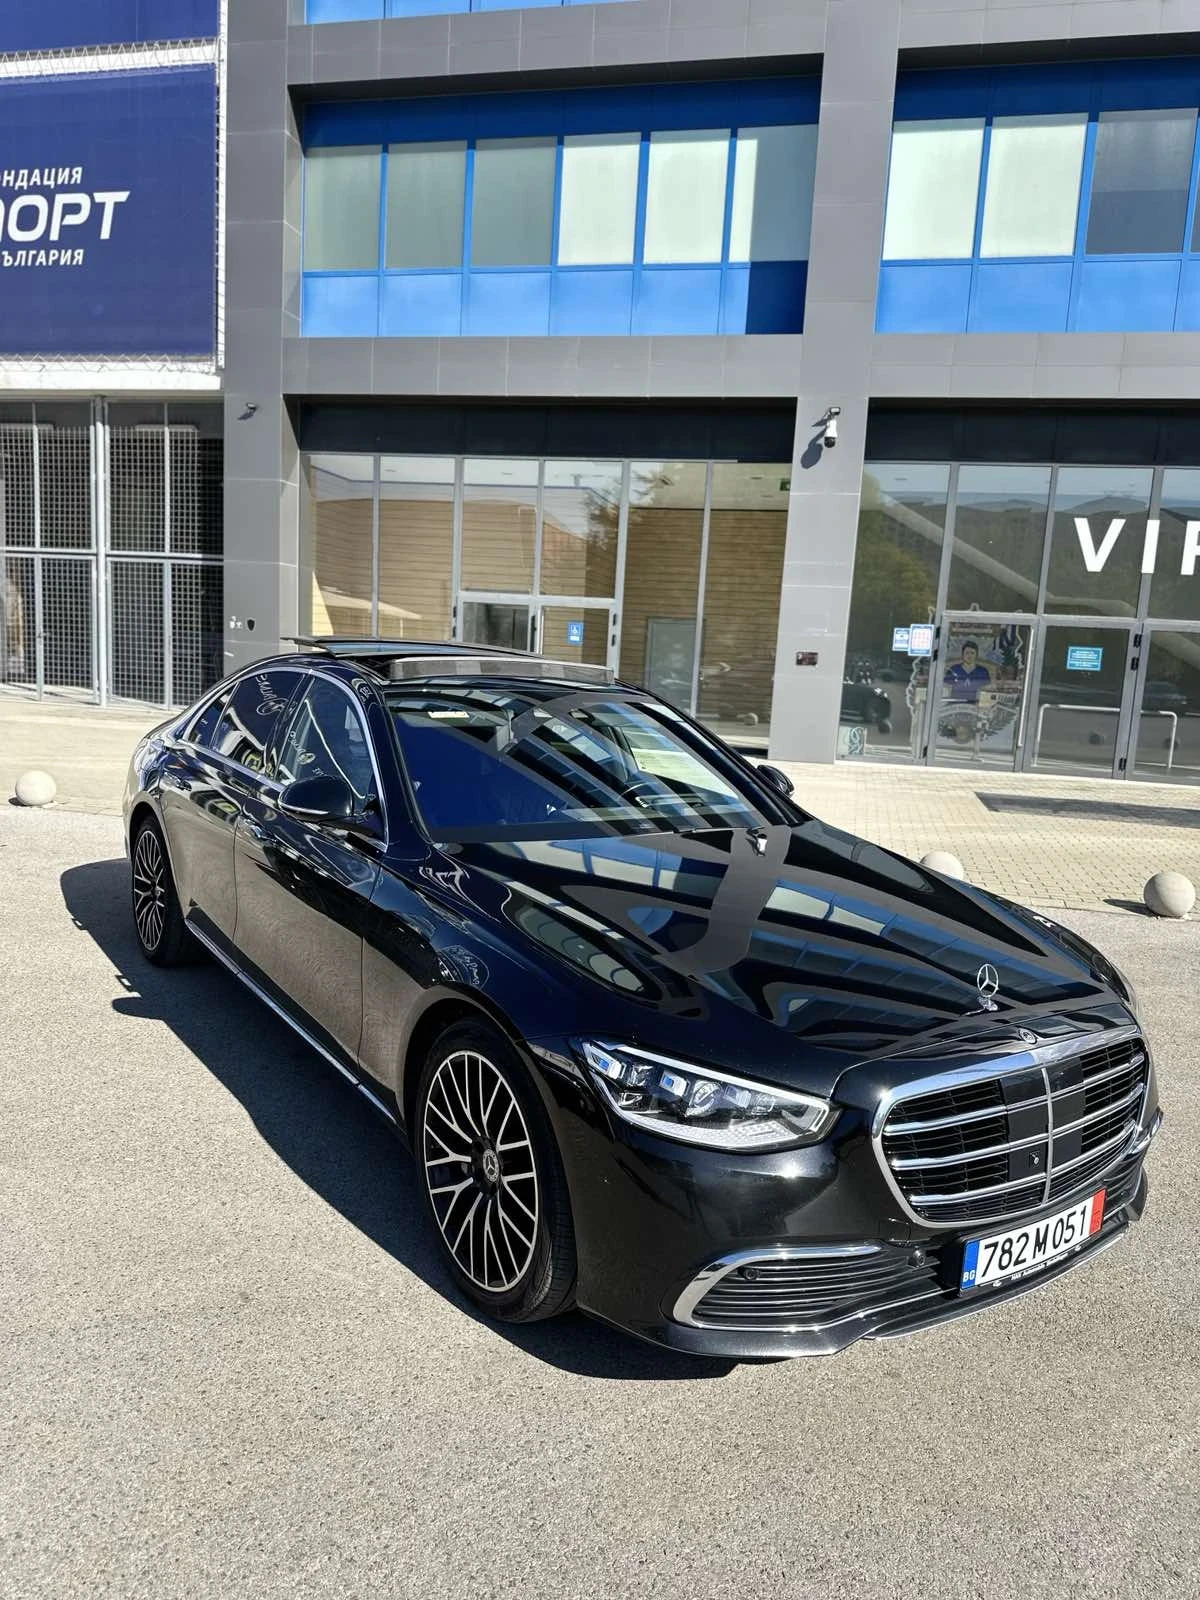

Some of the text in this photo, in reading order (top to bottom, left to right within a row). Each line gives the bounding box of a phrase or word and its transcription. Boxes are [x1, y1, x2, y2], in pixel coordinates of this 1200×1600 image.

[0, 167, 83, 190] НДАЦИЯ
[0, 191, 130, 241] ОРТ
[982, 1232, 1029, 1277] 782
[1033, 1224, 1049, 1258] M
[1052, 1206, 1087, 1249] 051
[963, 1269, 976, 1283] BG
